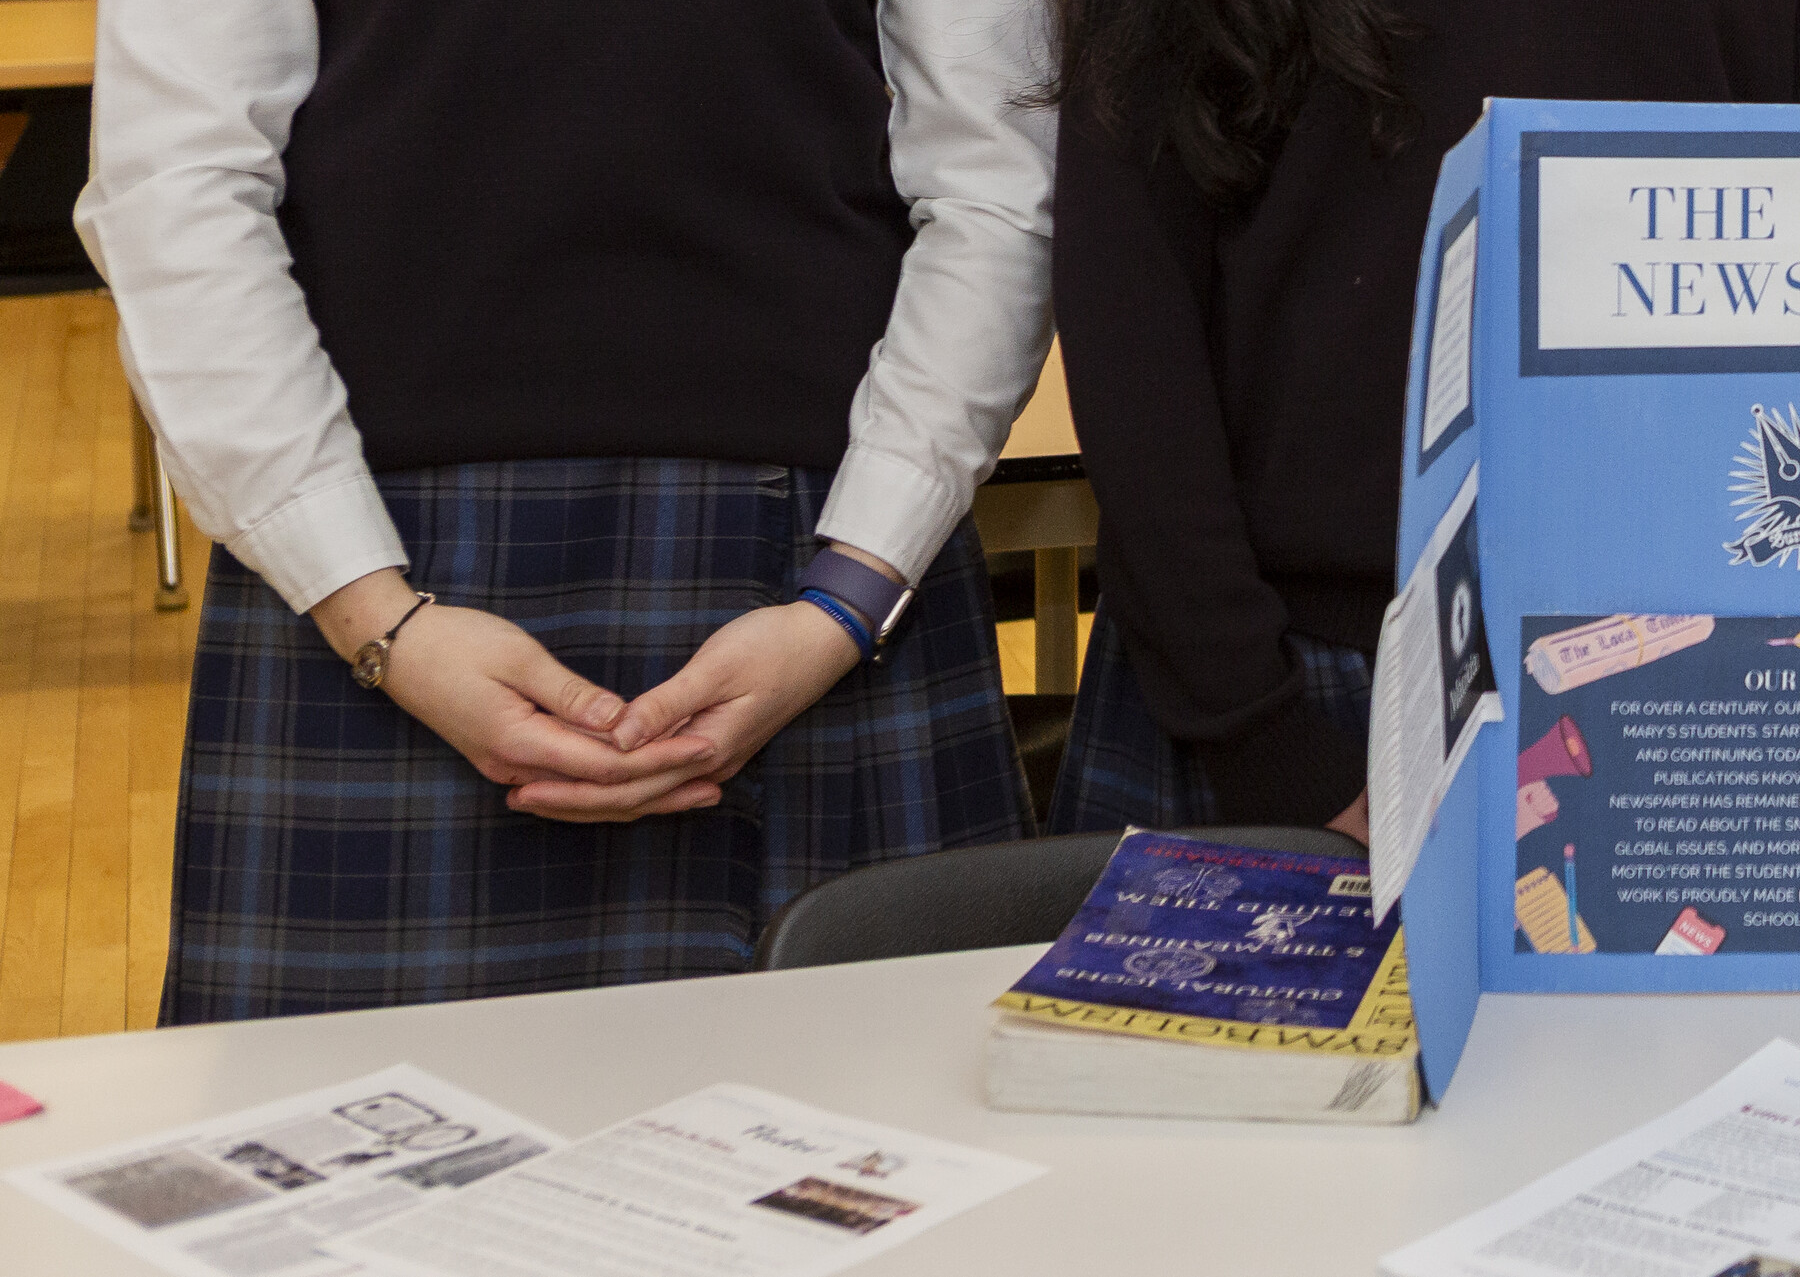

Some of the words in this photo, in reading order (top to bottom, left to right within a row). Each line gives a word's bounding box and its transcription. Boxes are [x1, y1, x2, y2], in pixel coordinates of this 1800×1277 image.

[1629, 185, 1776, 240] THE
[1558, 643, 1590, 664] The
[1744, 668, 1796, 691] OUR
[1610, 700, 1640, 716] FOR
[1643, 700, 1683, 716] OVER
[1685, 700, 1697, 716] A
[1699, 700, 1773, 716] CENTURY,
[1635, 747, 1668, 763] AND
[1670, 747, 1763, 763] CONTINUING
[1654, 771, 1758, 786] PUBLICATIONS
[1609, 794, 1699, 809] NEWSPAPER
[1702, 794, 1733, 809] HAS
[1635, 817, 1655, 832] TO
[1658, 817, 1698, 832] READ
[1700, 817, 1749, 832] ABOUT
[1753, 816, 1781, 832] THE
[1614, 841, 1674, 856] GLOBAL
[1732, 840, 1764, 855] AND
[1704, 864, 1733, 879] THE
[1116, 890, 1222, 911] THEM
[1616, 887, 1663, 903] WORK
[1666, 887, 1679, 903] IS
[1682, 887, 1750, 903] PROUDLY
[1754, 887, 1795, 902] MADE
[1743, 911, 1800, 926] SCHOOL
[1084, 931, 1268, 952] MEANINGS
[1679, 920, 1712, 948] NEWS
[1272, 941, 1337, 957] THE
[1055, 967, 1158, 988] ICONS
[1171, 979, 1343, 1002] CULTURAL
